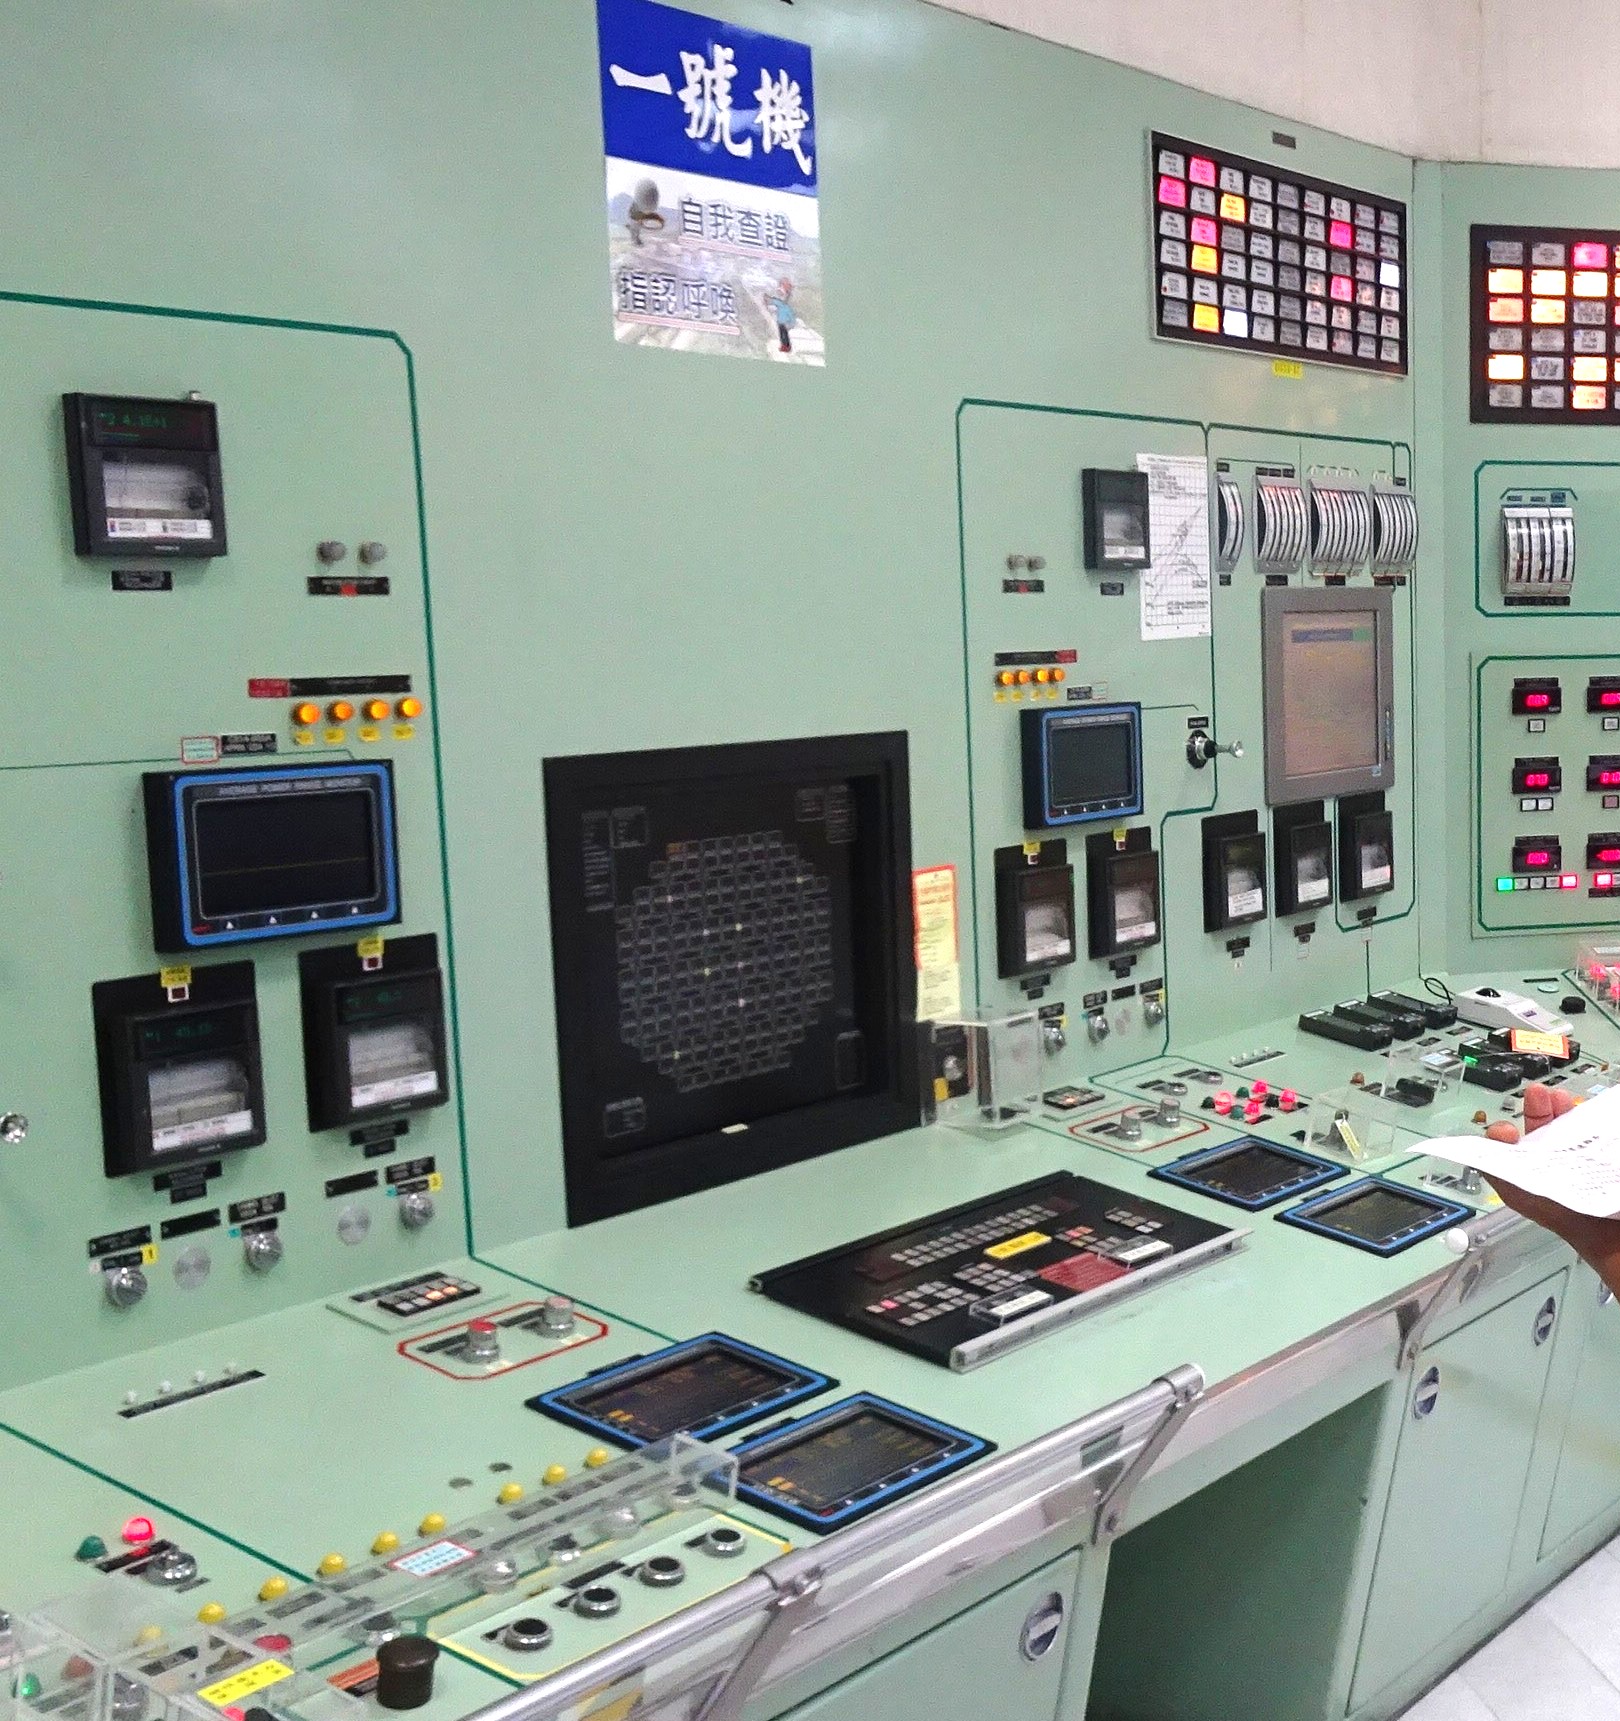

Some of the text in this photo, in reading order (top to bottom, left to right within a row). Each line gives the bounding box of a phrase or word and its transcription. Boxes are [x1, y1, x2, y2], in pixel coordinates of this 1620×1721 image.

[609, 44, 812, 176] 一號機
[681, 198, 790, 253] 自我查證
[618, 268, 738, 325] 指認呼喚
